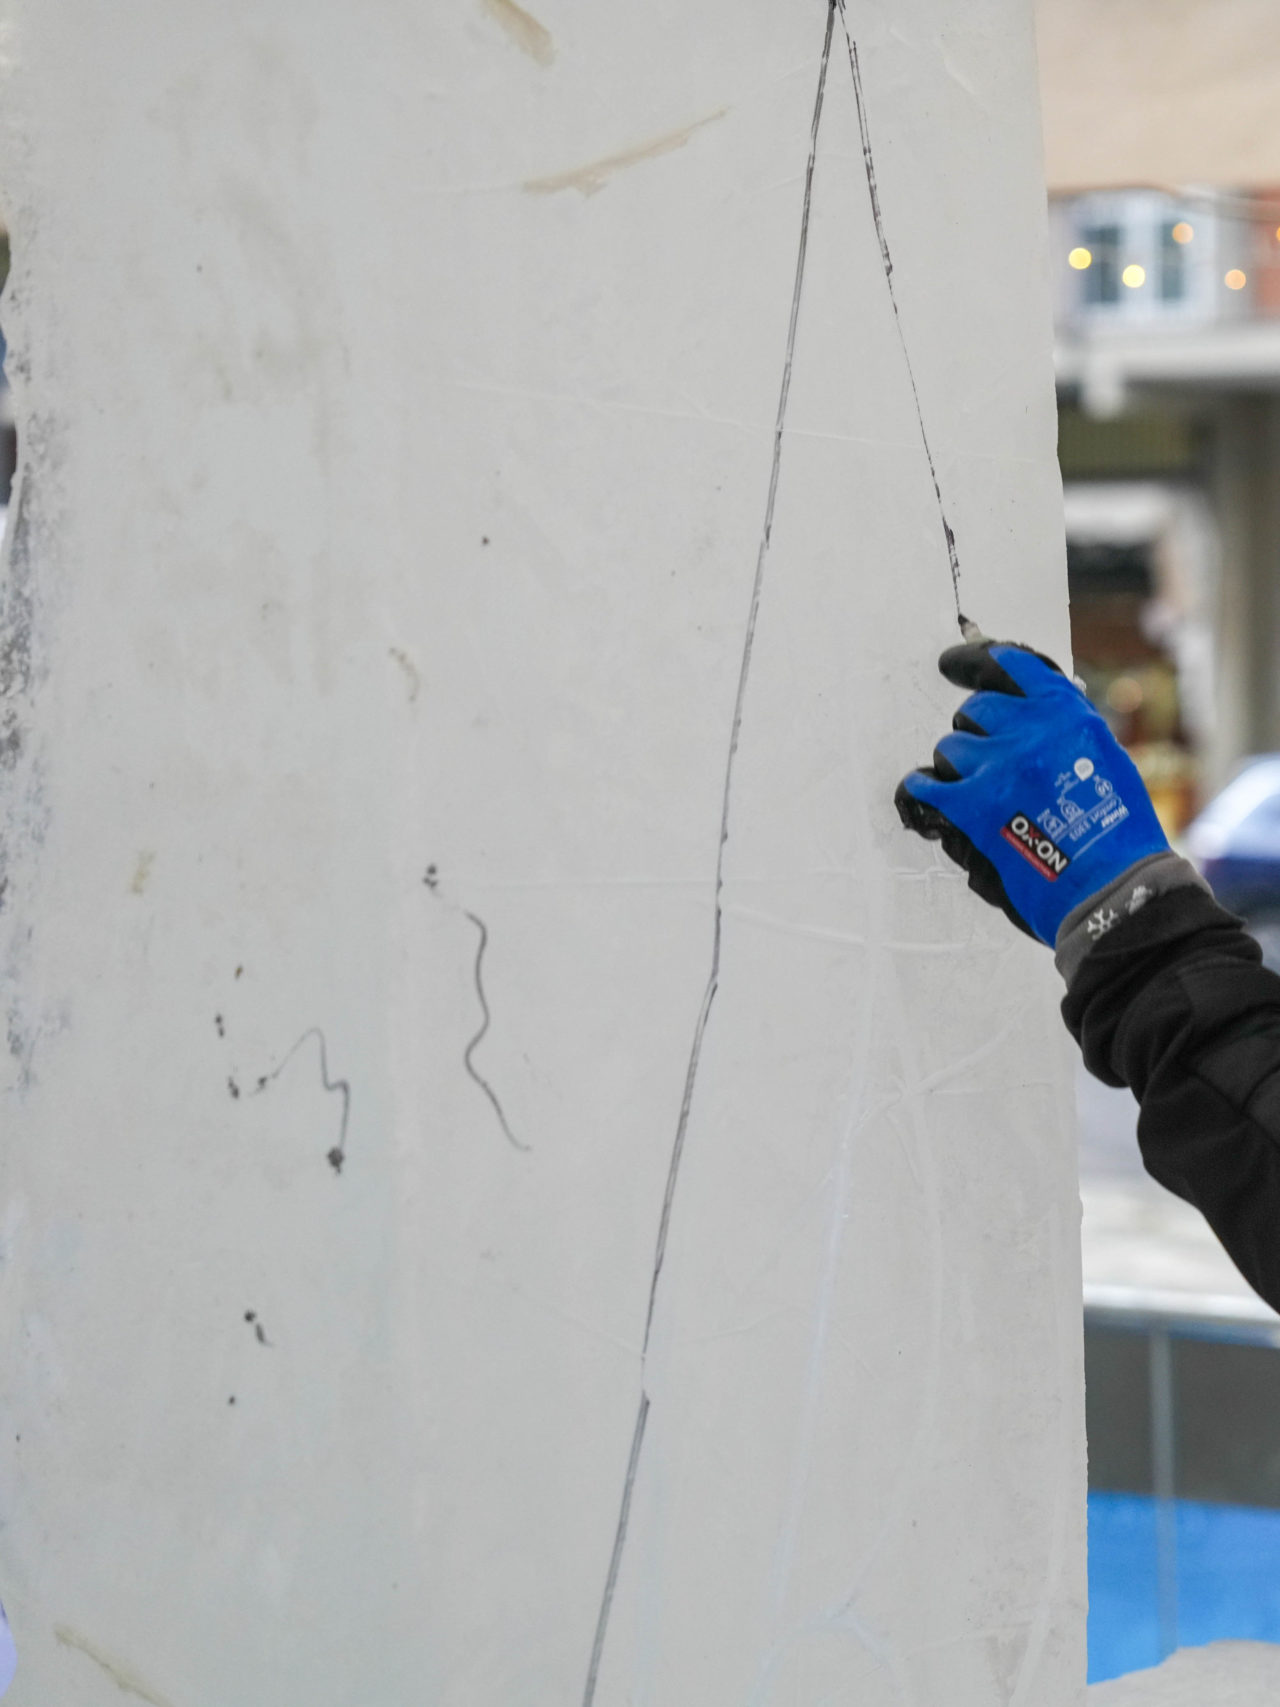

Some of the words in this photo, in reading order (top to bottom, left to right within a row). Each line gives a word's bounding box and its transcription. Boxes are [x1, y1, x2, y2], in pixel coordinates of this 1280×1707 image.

[1092, 797, 1122, 823] Comfort
[1102, 805, 1128, 828] Winter
[1011, 815, 1068, 873] OX-ON
